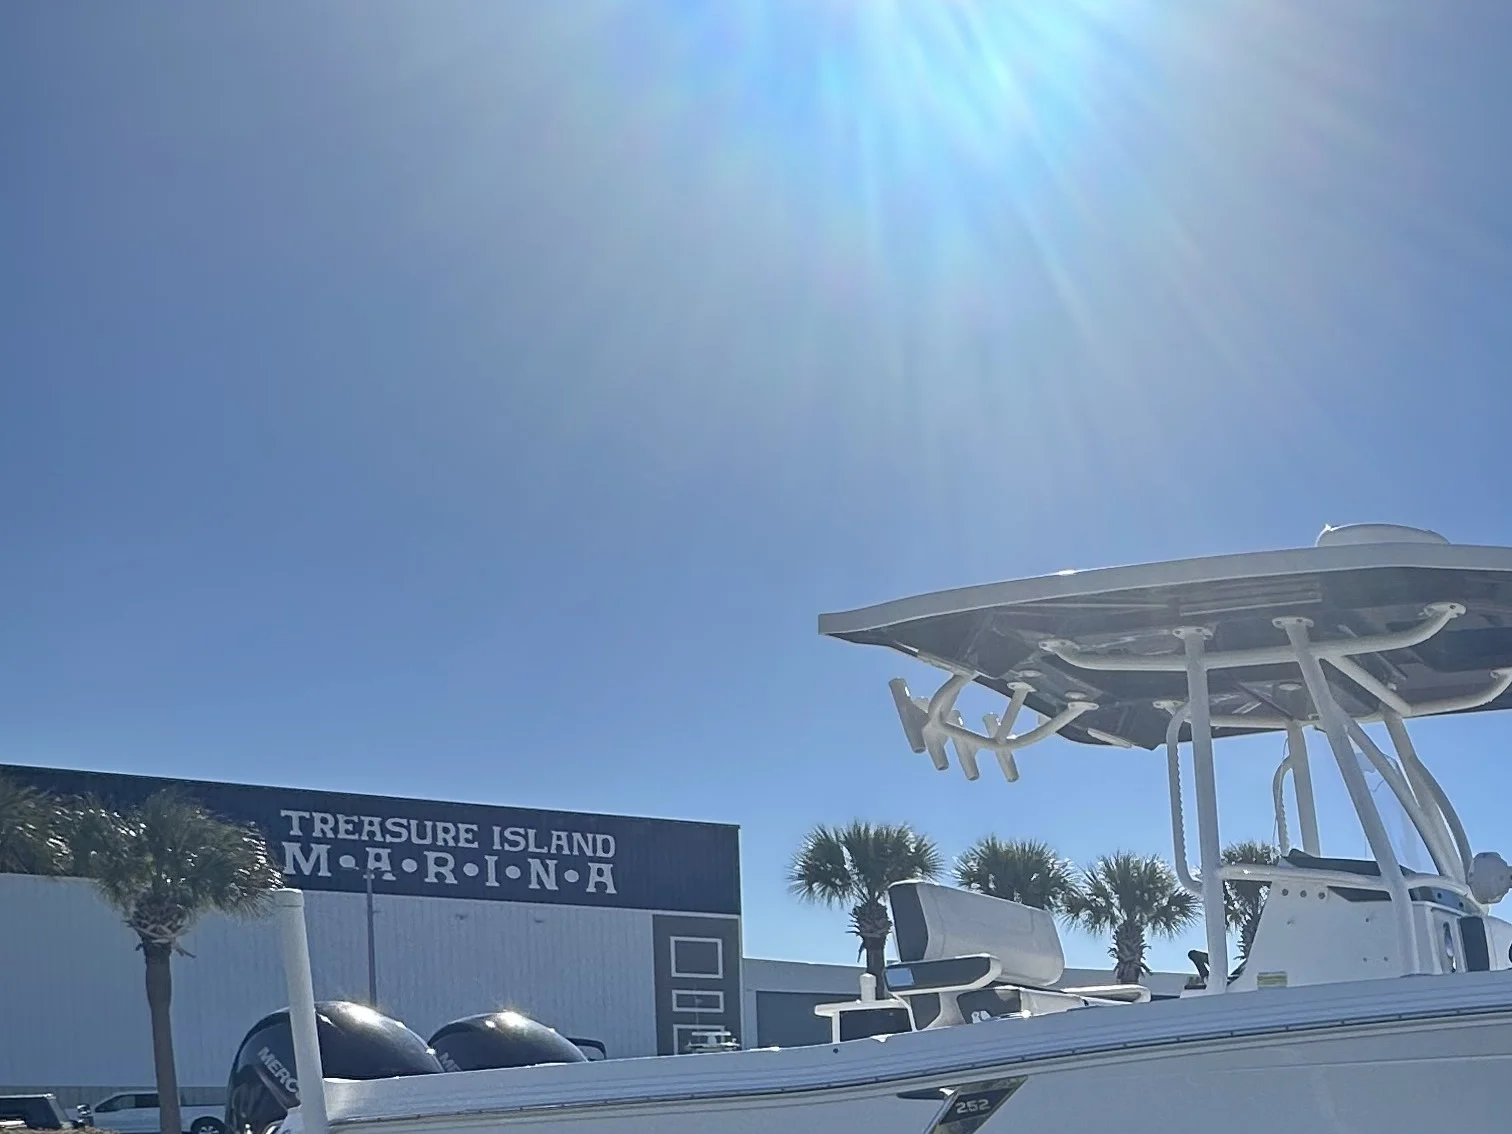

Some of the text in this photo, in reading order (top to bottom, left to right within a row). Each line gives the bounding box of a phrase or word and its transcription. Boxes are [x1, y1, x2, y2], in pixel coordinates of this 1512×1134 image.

[280, 809, 616, 858] TREASURE ISLAND
[955, 1098, 990, 1114] 252
